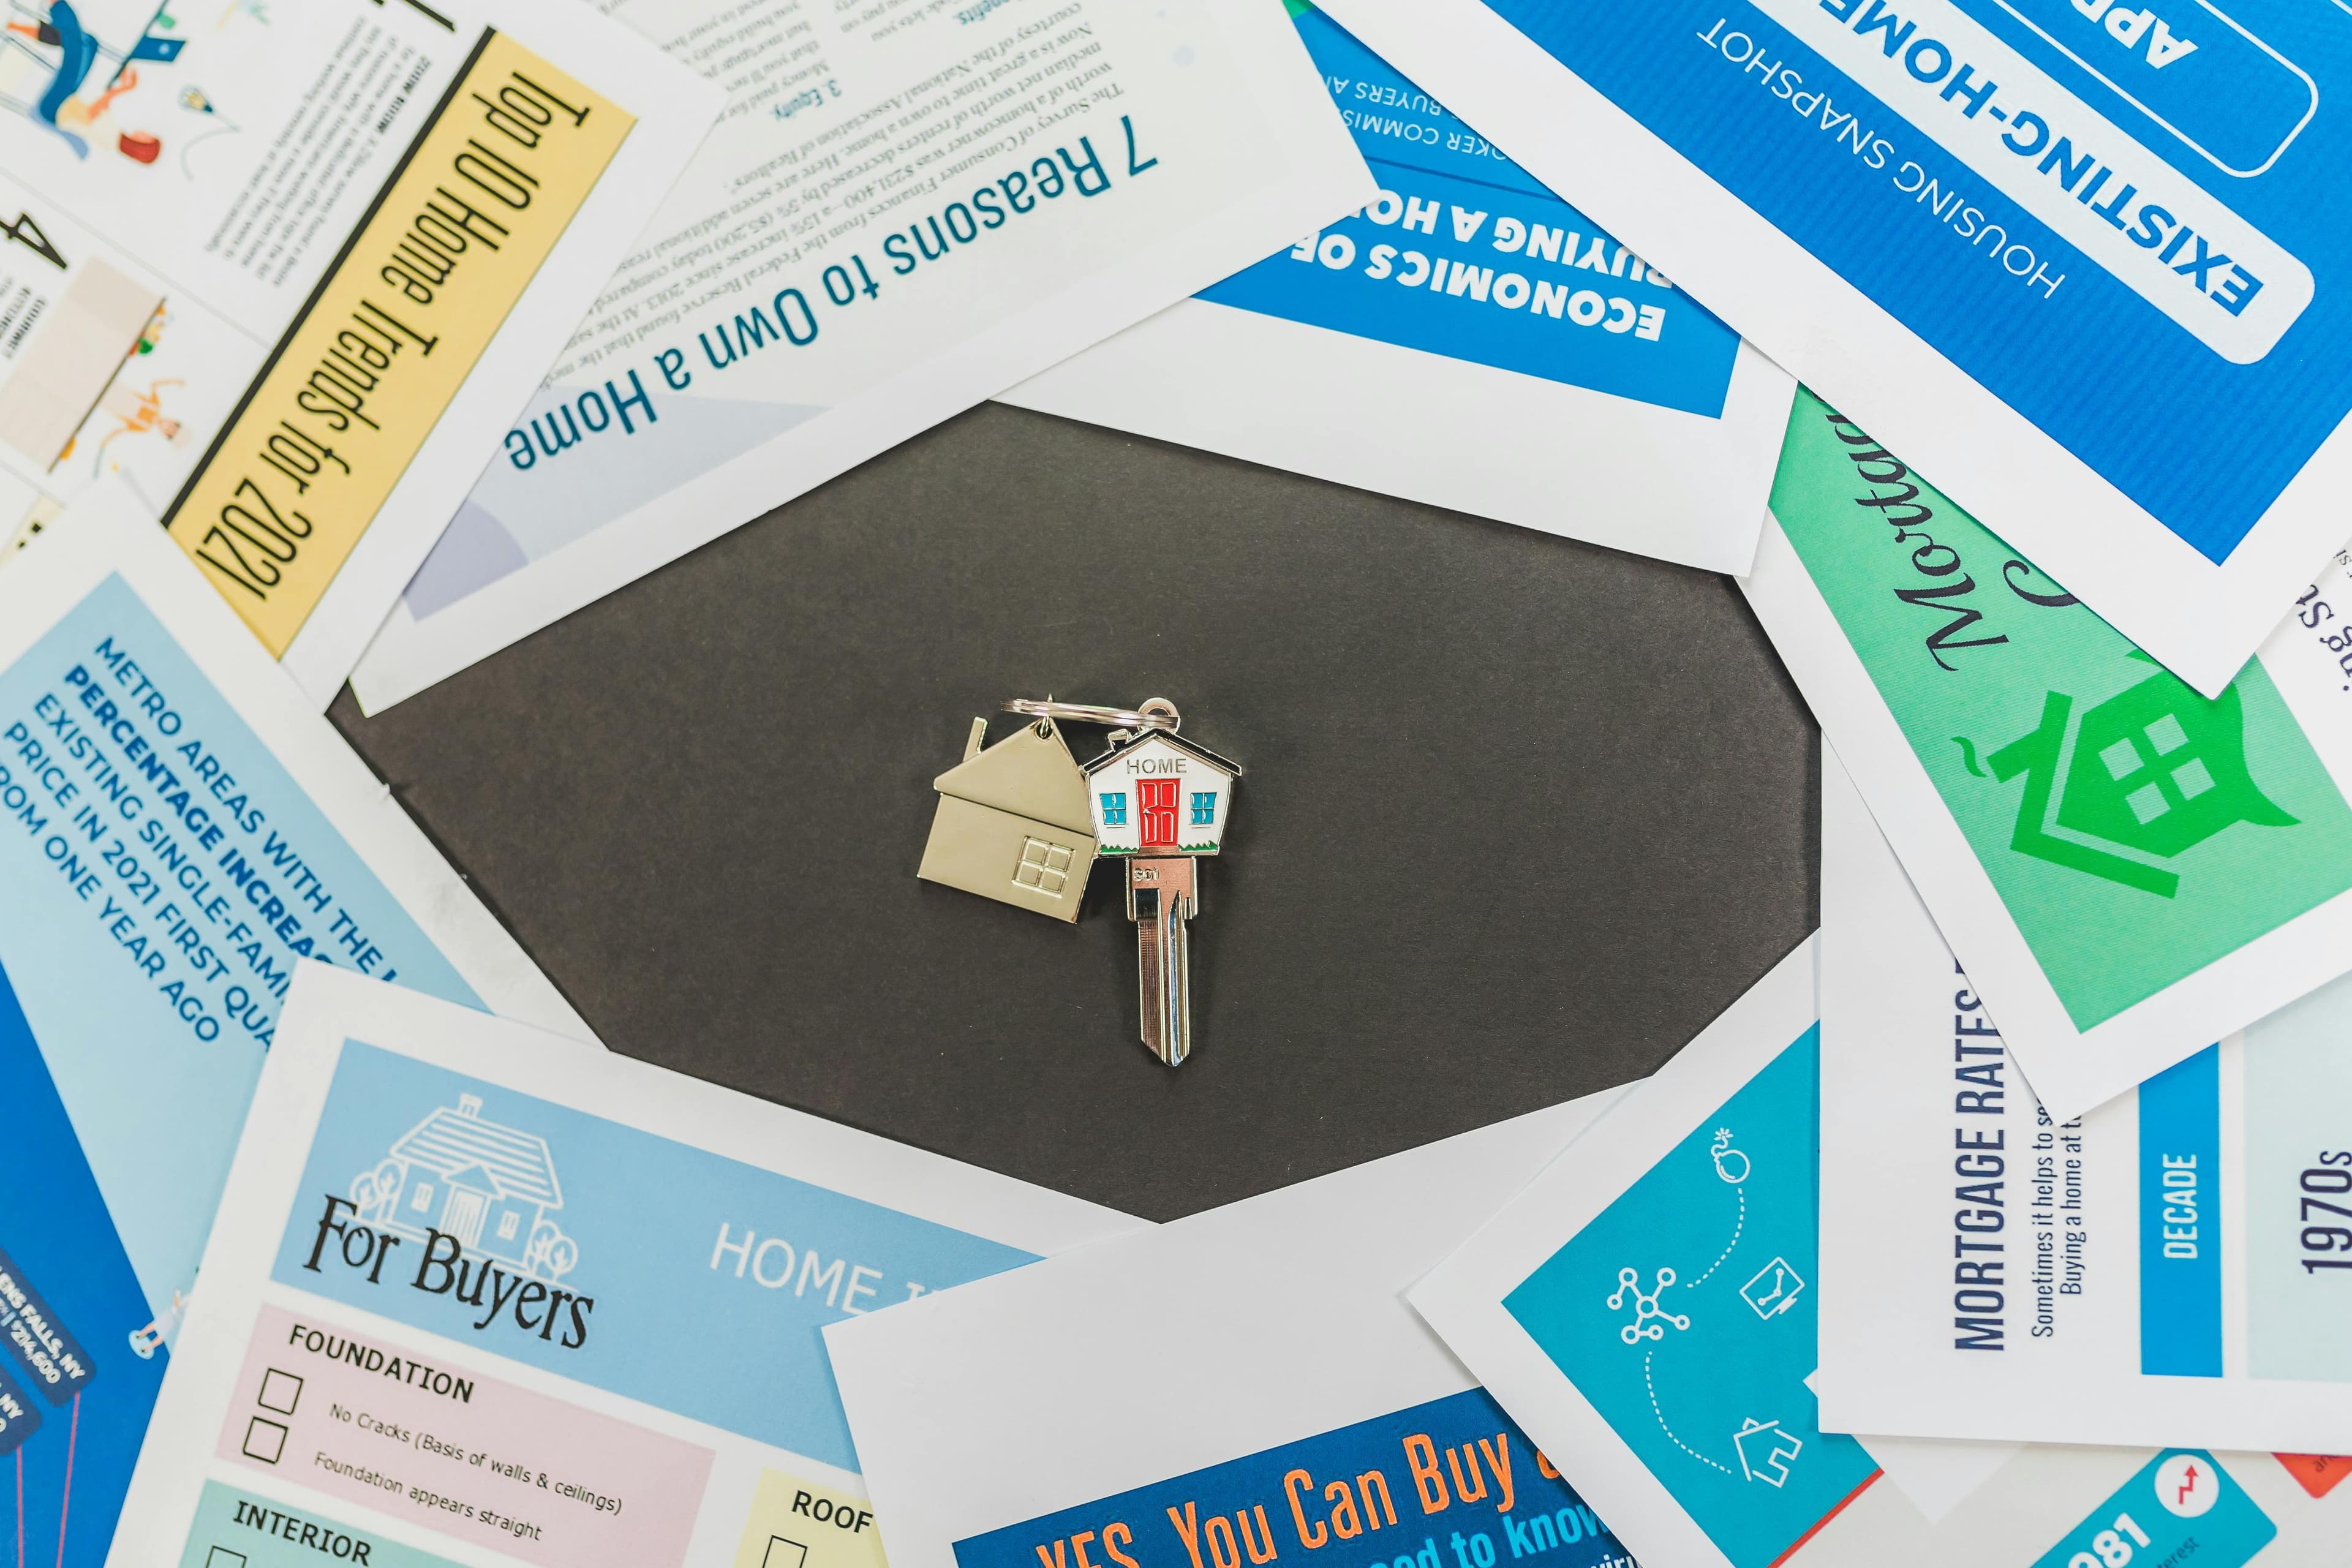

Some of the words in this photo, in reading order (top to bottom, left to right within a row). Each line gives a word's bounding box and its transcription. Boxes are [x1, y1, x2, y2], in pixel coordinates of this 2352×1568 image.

[1017, 2, 1082, 40] courtesy
[1057, 22, 1093, 47] Now
[972, 46, 998, 66] the
[994, 37, 1015, 56] of
[1028, 49, 1039, 59] a
[1039, 41, 1056, 55] is
[1043, 42, 1102, 77] median
[903, 60, 972, 104] National
[987, 51, 1028, 83] great
[1017, 72, 1043, 92] net
[1065, 62, 1113, 92] worth
[826, 78, 842, 98] 3.
[932, 96, 951, 110] to
[952, 77, 988, 100] time
[970, 88, 1017, 117] worth
[1036, 95, 1046, 105] a
[1048, 86, 1064, 105] of
[1092, 83, 1125, 103] The
[1696, 18, 1895, 169] SNAPSHOT
[472, 71, 590, 149] Top
[816, 95, 902, 146] Association
[897, 105, 932, 128] own
[948, 100, 1038, 153] homeowner
[952, 111, 969, 130] of
[1037, 97, 1091, 131] Survey
[1343, 110, 1439, 145] COMMIS
[840, 128, 889, 156] home.
[886, 123, 897, 134] a
[896, 119, 951, 154] renters
[1017, 126, 1035, 146] of
[1120, 115, 1158, 177] 7
[798, 140, 816, 160] of
[802, 153, 840, 178] Here
[915, 148, 946, 169] was
[940, 135, 1018, 183] Consumer
[454, 138, 540, 210] 10
[775, 173, 799, 192] are
[820, 148, 896, 197] decreased
[729, 187, 772, 215] seven
[776, 198, 801, 218] 5%
[801, 188, 822, 204] by
[867, 176, 938, 219] Finances
[883, 136, 1112, 276] Reasons
[1354, 191, 1441, 233] HO
[653, 210, 729, 258] additional
[790, 212, 821, 235] 15%
[827, 213, 868, 238] from
[1450, 206, 1488, 241] A
[1893, 160, 2065, 299] HOUSING
[380, 187, 510, 305] Home
[671, 243, 714, 269] today
[726, 228, 790, 267] increase
[803, 233, 828, 252] the
[685, 262, 724, 288] since
[743, 247, 802, 287] Federal
[822, 254, 880, 306] to
[595, 265, 669, 312] compared
[644, 282, 684, 311] 2013.
[682, 277, 743, 314] Reserve
[1364, 244, 1666, 342] ECONOMICS
[597, 314, 622, 333] the
[622, 303, 639, 322] At
[635, 309, 681, 342] found
[698, 288, 819, 370] Own
[564, 352, 598, 375] the
[594, 332, 635, 361] that
[296, 300, 439, 432] Trends
[654, 348, 692, 391] a
[503, 369, 658, 470] Home
[259, 421, 350, 496] for
[195, 478, 313, 601] 2021
[64, 664, 225, 852] PERCENTAGE
[1126, 758, 1186, 774] HOME
[94, 636, 182, 736] METRO
[176, 740, 265, 834] AREAS
[262, 830, 333, 914] WITH
[329, 908, 383, 974] THE
[4, 721, 79, 809] PRICE
[73, 805, 108, 843] IN
[101, 840, 160, 905] 2021
[155, 902, 230, 982] FIRST
[34, 693, 144, 821] EXISTING
[138, 820, 290, 999] SINGLE-FAMI
[44, 835, 102, 901] ONE
[99, 895, 166, 979] YEAR
[159, 981, 220, 1042] AGO
[2032, 1133, 2054, 1151] to
[2060, 1135, 2081, 1153] at
[2031, 1156, 2064, 1209] helps
[2059, 1159, 2081, 1210] home
[2032, 1213, 2053, 1226] it
[2065, 1216, 2081, 1226] a
[2162, 1153, 2198, 1259] DECADE
[2299, 1150, 2352, 1275] 1970s
[1954, 1128, 2005, 1351] MORTGAGE
[302, 1194, 401, 1285] For
[410, 1227, 594, 1349] Buyers
[709, 1223, 883, 1314] HOME
[2059, 1231, 2087, 1295] Buying
[2031, 1232, 2054, 1338] Sometimes
[59, 1353, 85, 1379] NY
[289, 1324, 474, 1403] FOUNDATION
[330, 1403, 352, 1423] No
[357, 1412, 410, 1442] Cracks
[415, 1433, 464, 1461] (Basis
[469, 1453, 488, 1468] of
[491, 1460, 531, 1483] walls
[537, 1472, 548, 1490] &
[554, 1482, 622, 1516] ceilings)
[314, 1452, 403, 1494] Foundation
[409, 1487, 474, 1518] appears
[478, 1510, 542, 1541] straight
[791, 1489, 874, 1534] ROOF
[1166, 1501, 1278, 1568] You
[1283, 1468, 1398, 1549] Can
[1402, 1433, 1515, 1515] Buy
[233, 1500, 371, 1567] INTERIOR
[1450, 1531, 1496, 1568] to
